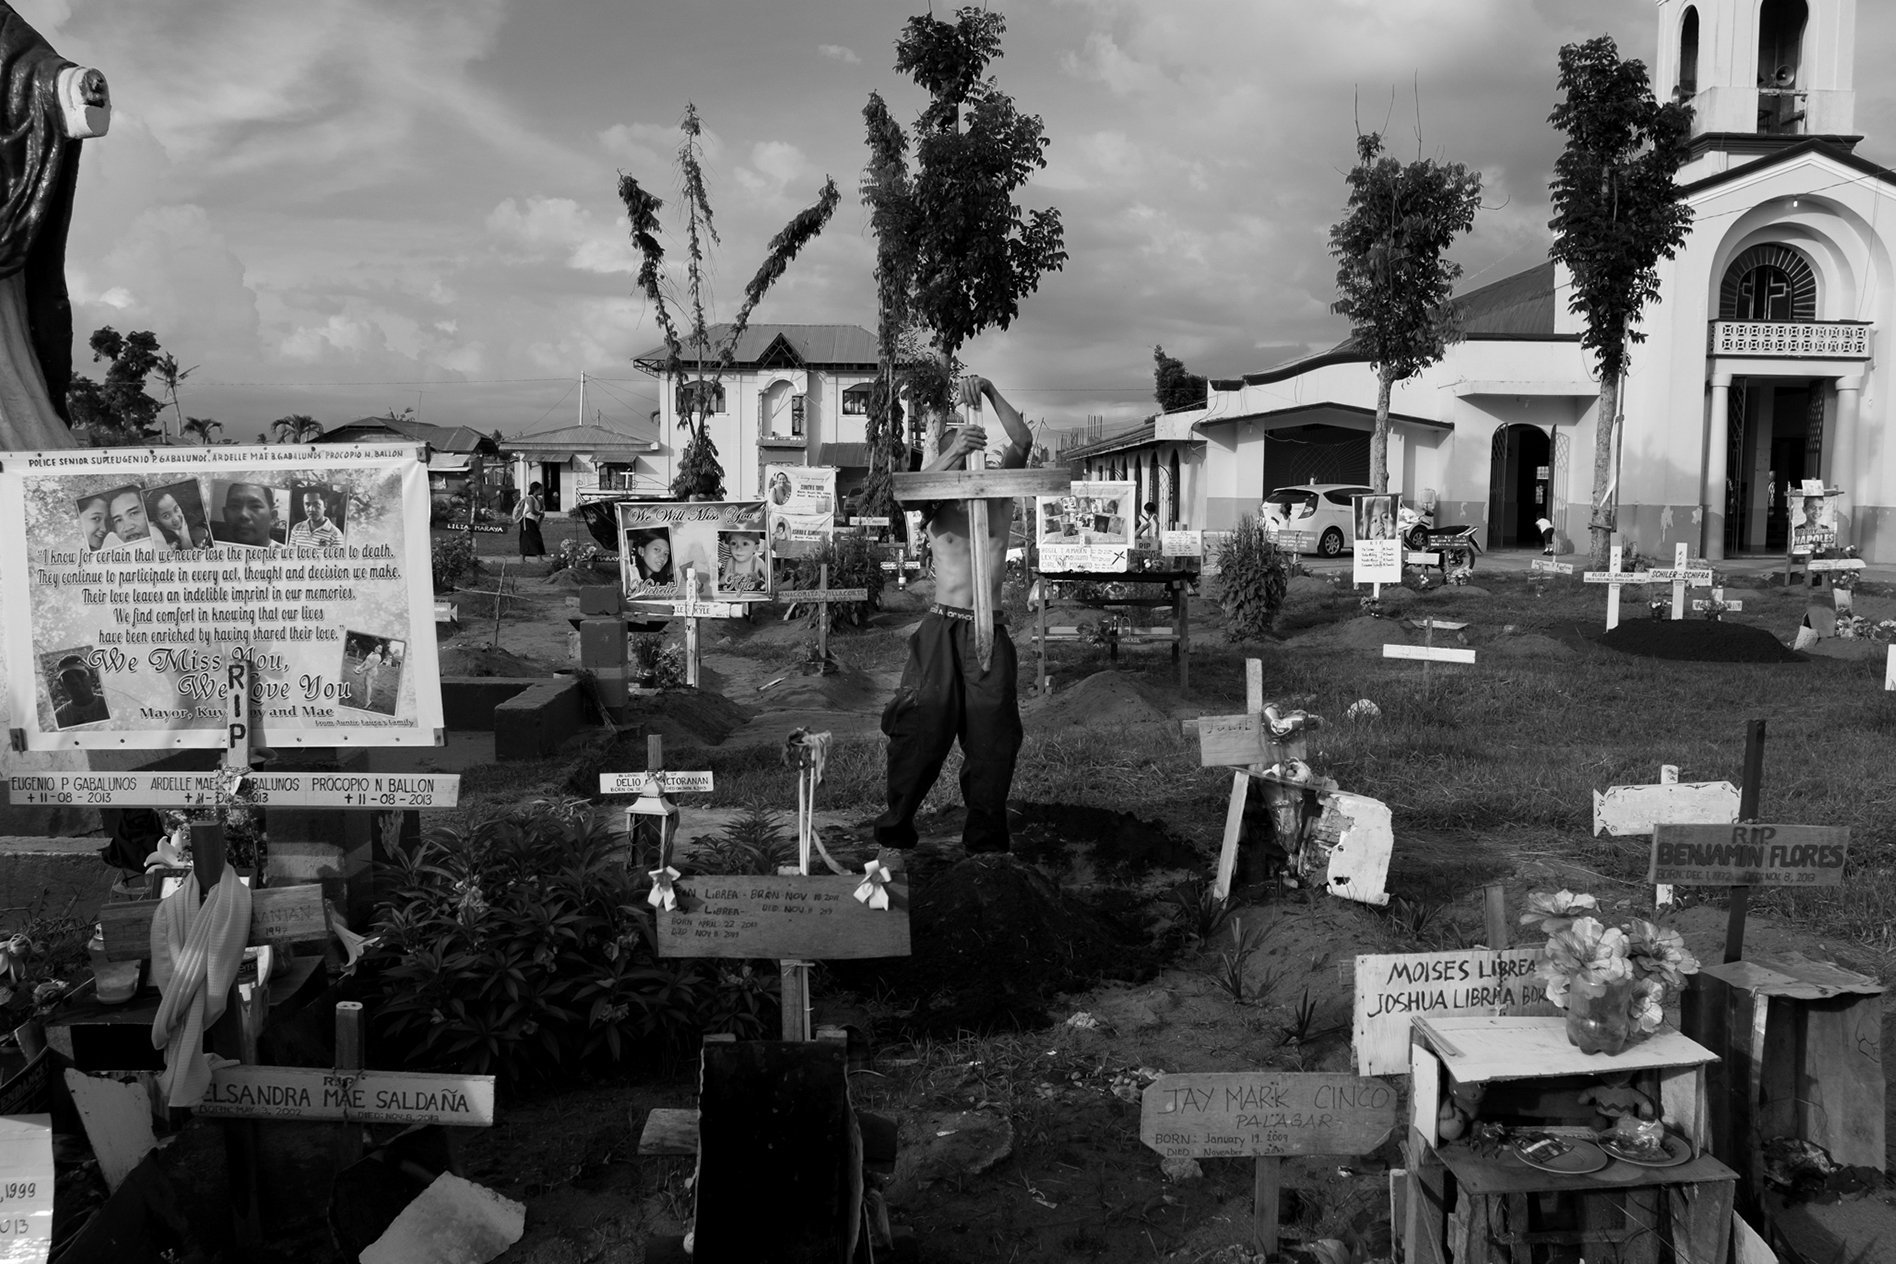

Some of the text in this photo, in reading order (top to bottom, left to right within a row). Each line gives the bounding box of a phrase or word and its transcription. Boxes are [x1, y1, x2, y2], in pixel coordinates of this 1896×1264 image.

[28, 458, 56, 467] POLICE
[59, 457, 89, 466] SENIOR
[212, 453, 247, 462] ARDELLE
[374, 450, 403, 459] BALLON
[628, 507, 651, 522] We
[656, 506, 685, 522] Will
[688, 506, 720, 522] Miss
[50, 549, 75, 564] know
[78, 548, 92, 568] for
[96, 549, 131, 563] certain
[134, 548, 155, 563] that
[158, 550, 172, 563] we
[174, 550, 202, 562] never
[205, 548, 223, 562] lose
[227, 547, 241, 560] the
[245, 546, 277, 564] people
[280, 548, 293, 560] we
[323, 547, 345, 559] even
[348, 545, 359, 559] to
[361, 544, 394, 559] death.
[37, 569, 58, 588] They
[62, 570, 102, 584] continue
[106, 569, 115, 583] to
[118, 568, 174, 586] participate
[178, 568, 188, 582] in
[191, 569, 218, 586] every
[244, 566, 282, 584] thought
[285, 565, 305, 580] and
[308, 564, 349, 580] decision
[353, 566, 366, 579] we
[369, 564, 401, 579] make.
[724, 573, 755, 598] Kyle
[82, 585, 356, 604] Their love leaves an indelible imprint in our memories.
[628, 578, 678, 597] Michelle
[113, 606, 323, 627] We find comfort in knowing that our lives
[99, 629, 123, 644] have
[126, 629, 147, 643] been
[151, 628, 195, 643] enriched
[199, 627, 210, 645] by
[214, 628, 249, 644] having
[253, 626, 286, 641] shared
[290, 626, 313, 640] their
[87, 647, 138, 673] We
[148, 648, 222, 672] Miss
[178, 672, 227, 699] We
[300, 674, 352, 700] You
[140, 708, 193, 721] Mayor,
[197, 707, 227, 721] Kuy
[269, 706, 298, 718] and
[302, 706, 334, 718] Mae
[11, 777, 137, 791] EUGENIO P GABALUNOS
[151, 777, 192, 791] ARDELLE
[195, 777, 215, 790] MAE
[312, 777, 434, 793] PROCOPIO N BALLON
[616, 778, 641, 787] DELIO
[1657, 843, 1845, 868] BENJAMIN FLORES
[785, 891, 808, 902] NOV
[1387, 958, 1536, 985] MOISES LIBREA
[1367, 989, 1448, 1017] JOSHUA
[324, 1089, 365, 1108] MAE
[376, 1088, 470, 1113] SALDAÑA
[1157, 1085, 1390, 1115] JAY MARK CINCO
[1204, 1133, 1245, 1146] January
[1267, 1133, 1288, 1143] 2009
[1203, 1147, 1242, 1157] November
